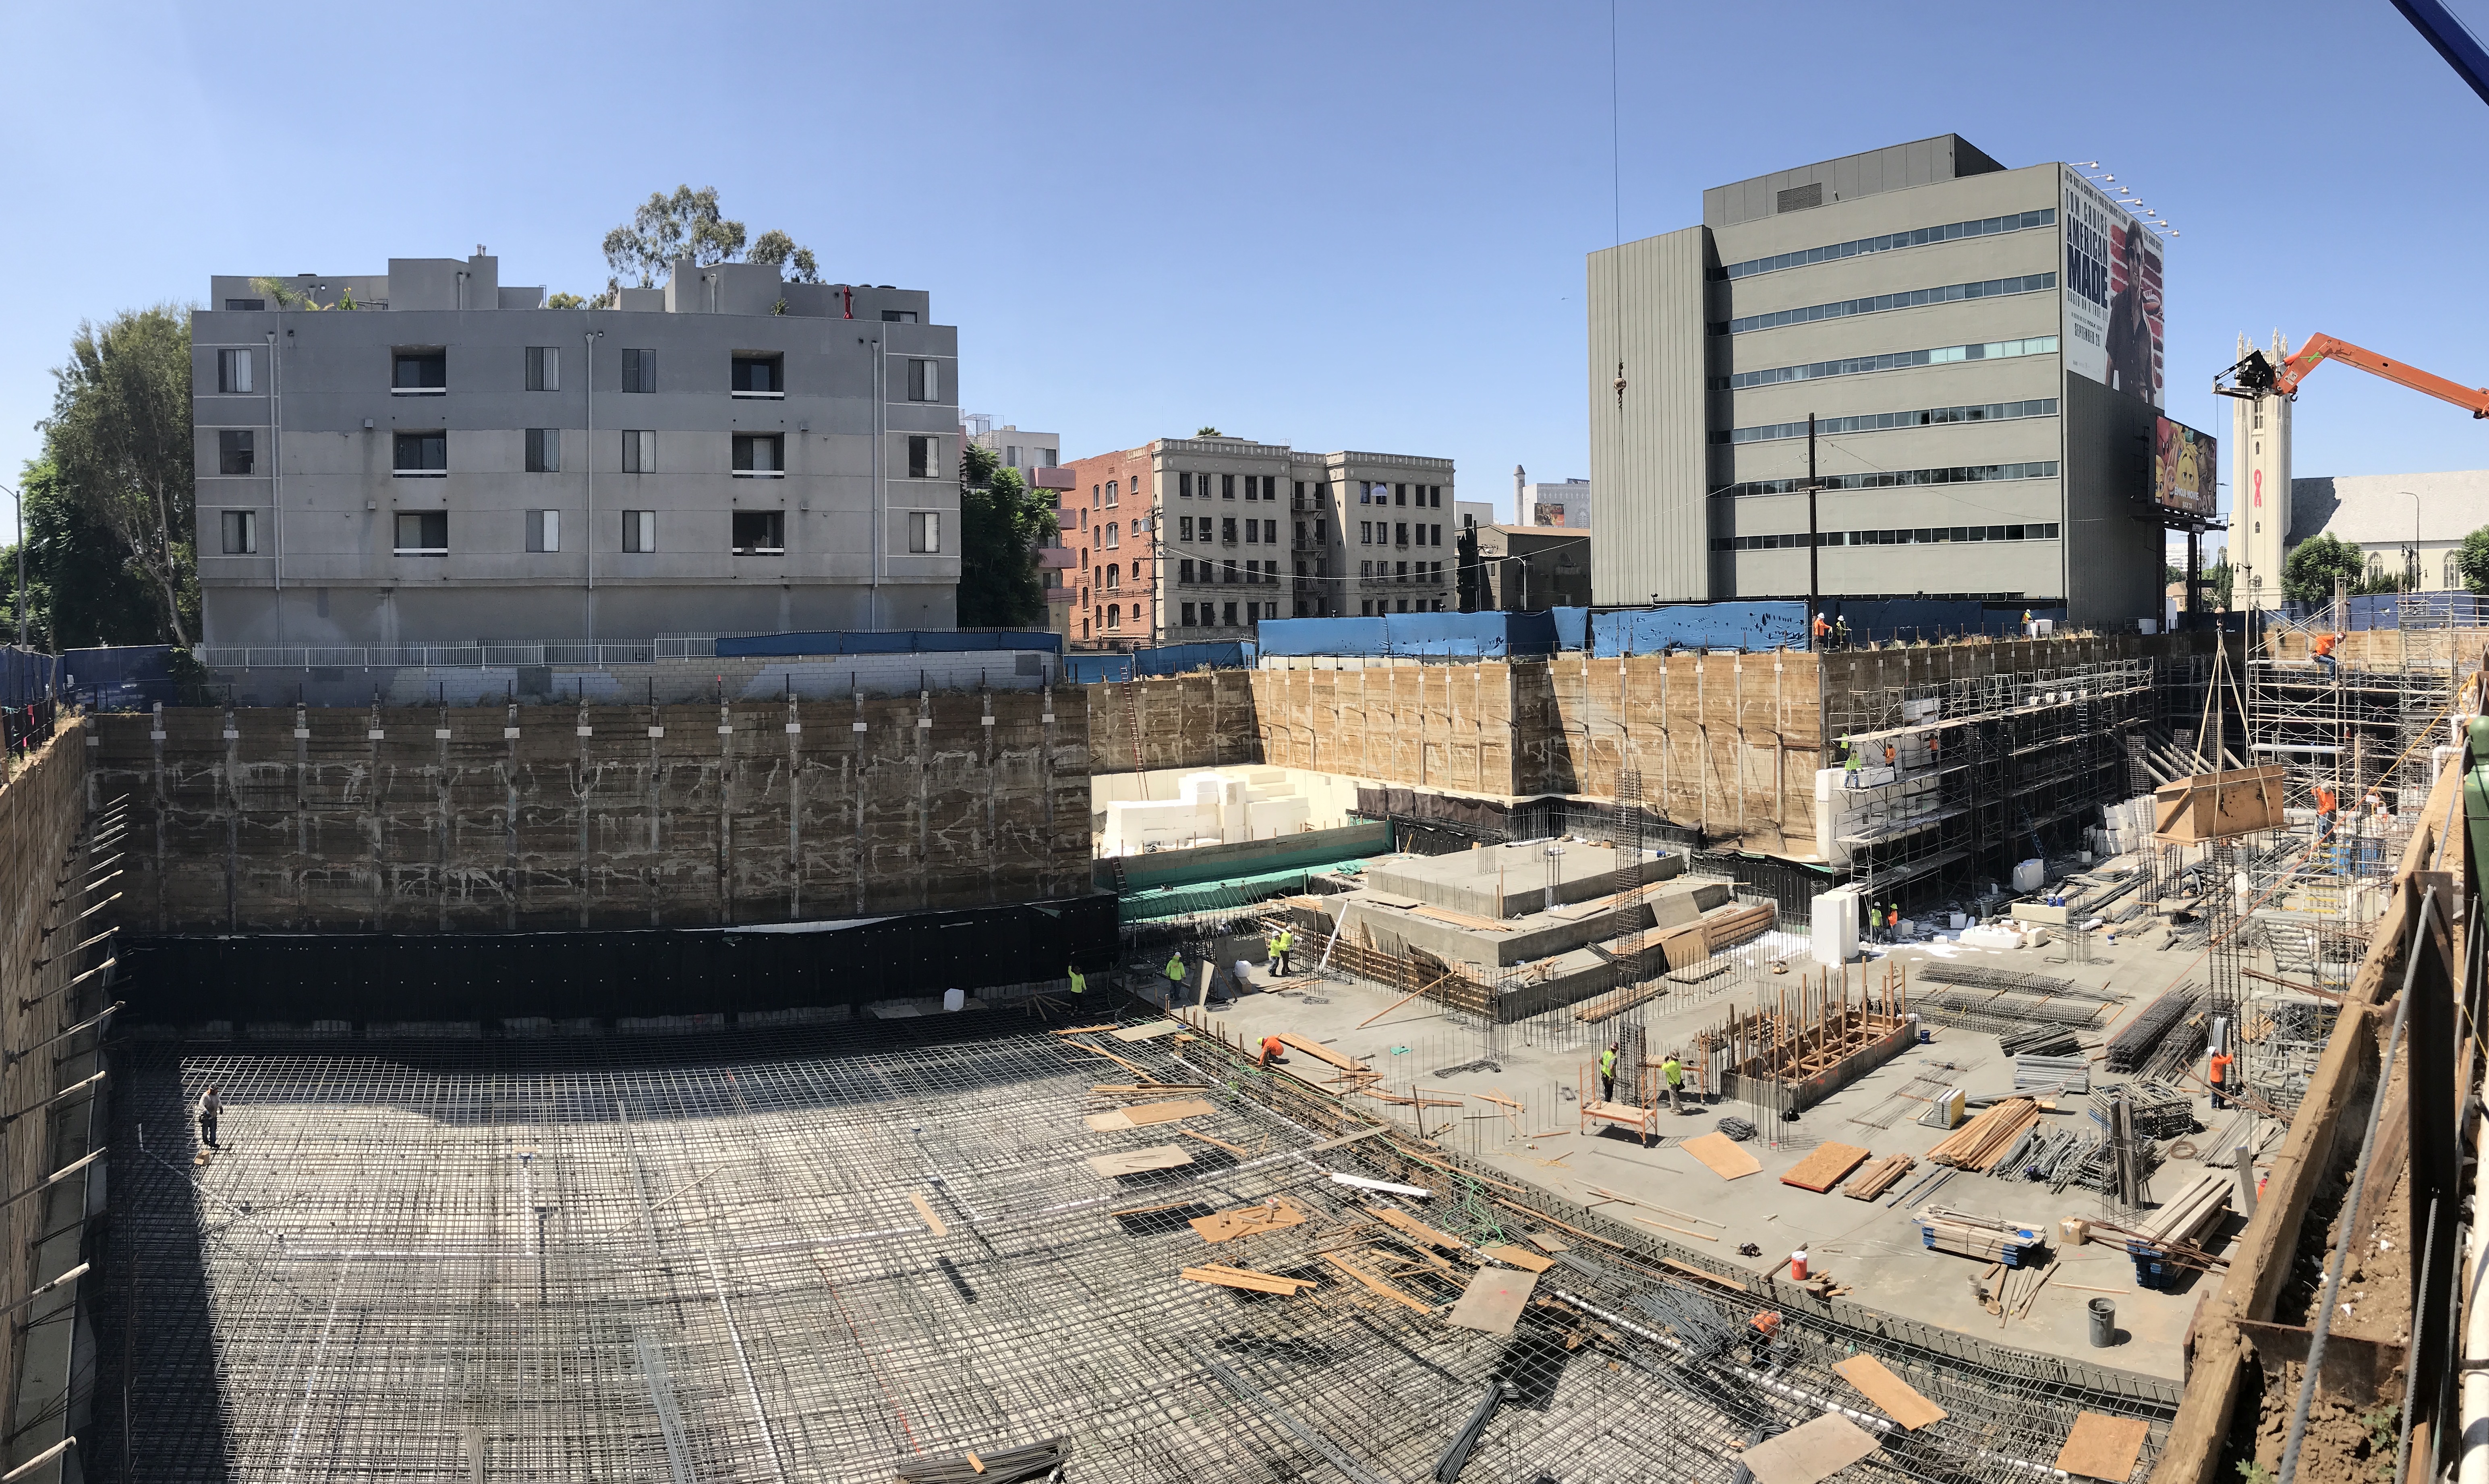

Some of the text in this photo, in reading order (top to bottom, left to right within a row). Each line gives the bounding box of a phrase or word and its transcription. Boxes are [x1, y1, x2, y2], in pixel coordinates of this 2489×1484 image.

[2066, 188, 2107, 237] TOM CRUISE
[2081, 182, 2083, 192] A
[2084, 184, 2093, 200] CRIME
[2095, 192, 2097, 203] IF
[2098, 195, 2108, 211] YOU'RE
[2109, 204, 2118, 219] DOING
[2118, 211, 2121, 221] IT
[2067, 213, 2108, 267] AMERICAN
[2067, 243, 2108, 310] MADE
[2068, 290, 2079, 307] BASED
[2082, 298, 2086, 310] ON
[2089, 302, 2091, 313] A
[2075, 323, 2094, 344] SEPTEMBER
[2087, 320, 2095, 329] IMAX
[2174, 486, 2199, 501] EMOJI MOVIE
